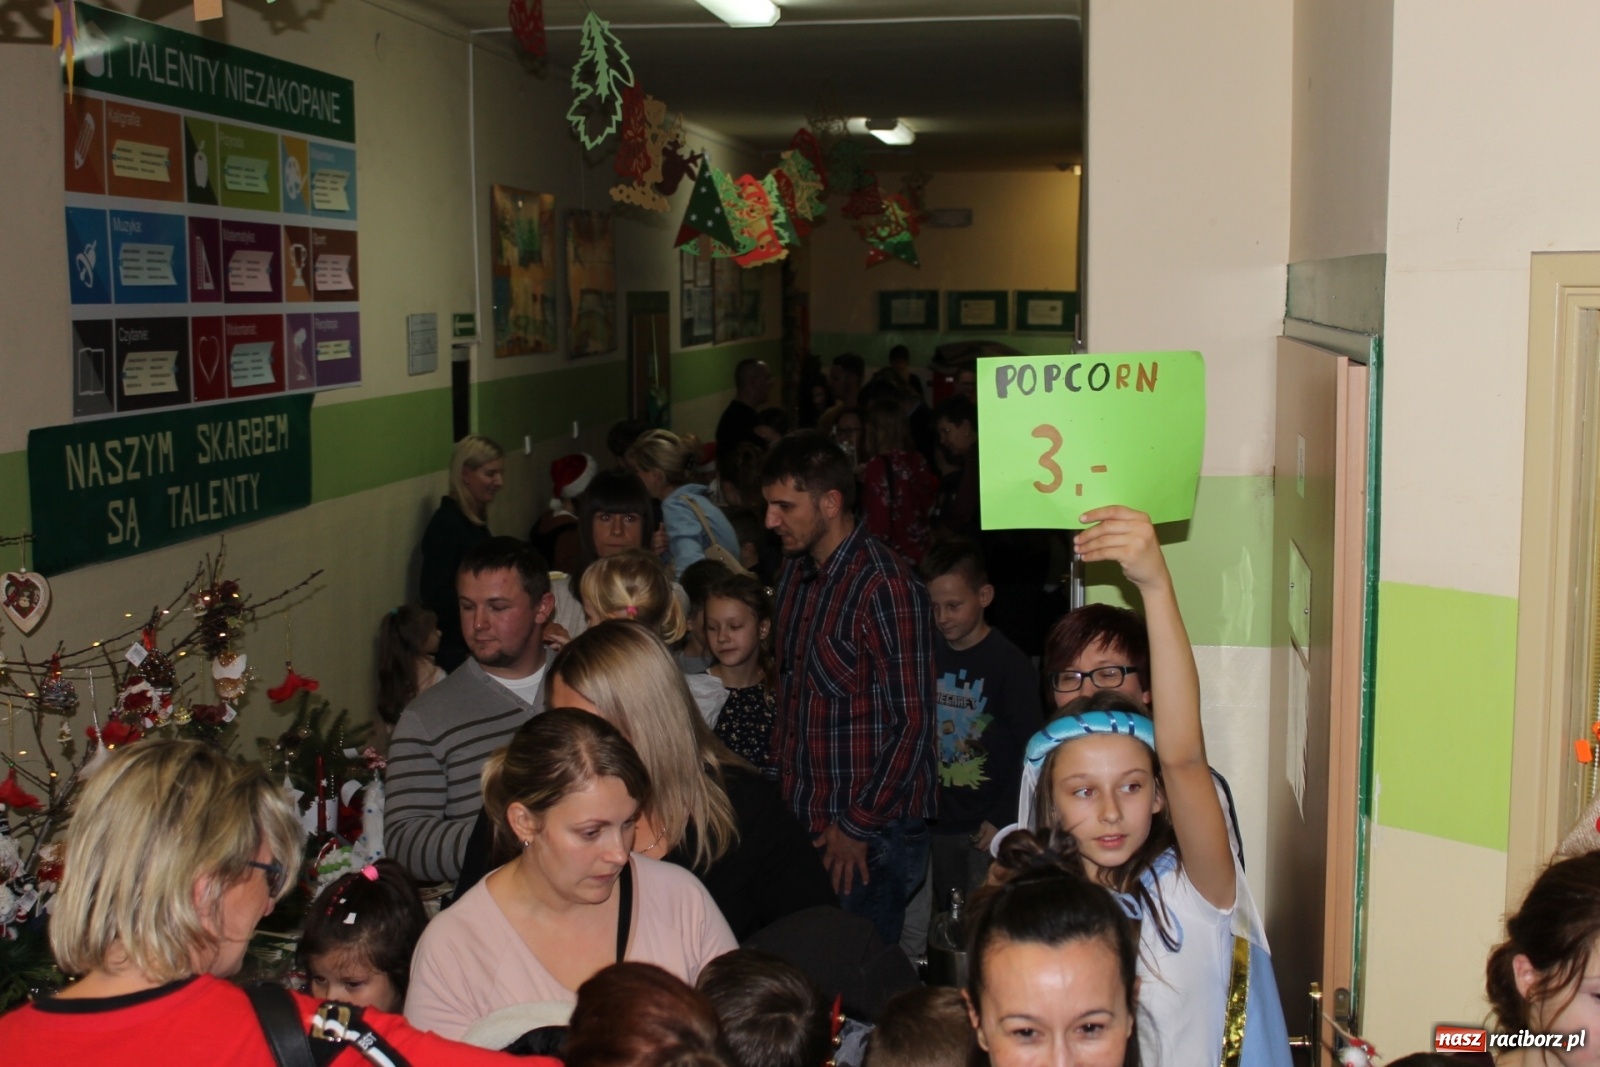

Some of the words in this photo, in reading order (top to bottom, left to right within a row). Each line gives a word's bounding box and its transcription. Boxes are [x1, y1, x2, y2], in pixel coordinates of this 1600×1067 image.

[124, 36, 220, 95] TALENTY
[224, 63, 342, 124] NIEZAKOPANE
[995, 361, 1159, 399] POPCORN
[65, 431, 175, 491] NASZYM
[197, 413, 289, 465] SKARBEM
[107, 497, 141, 548] SĄ
[167, 472, 261, 529] TALENTY
